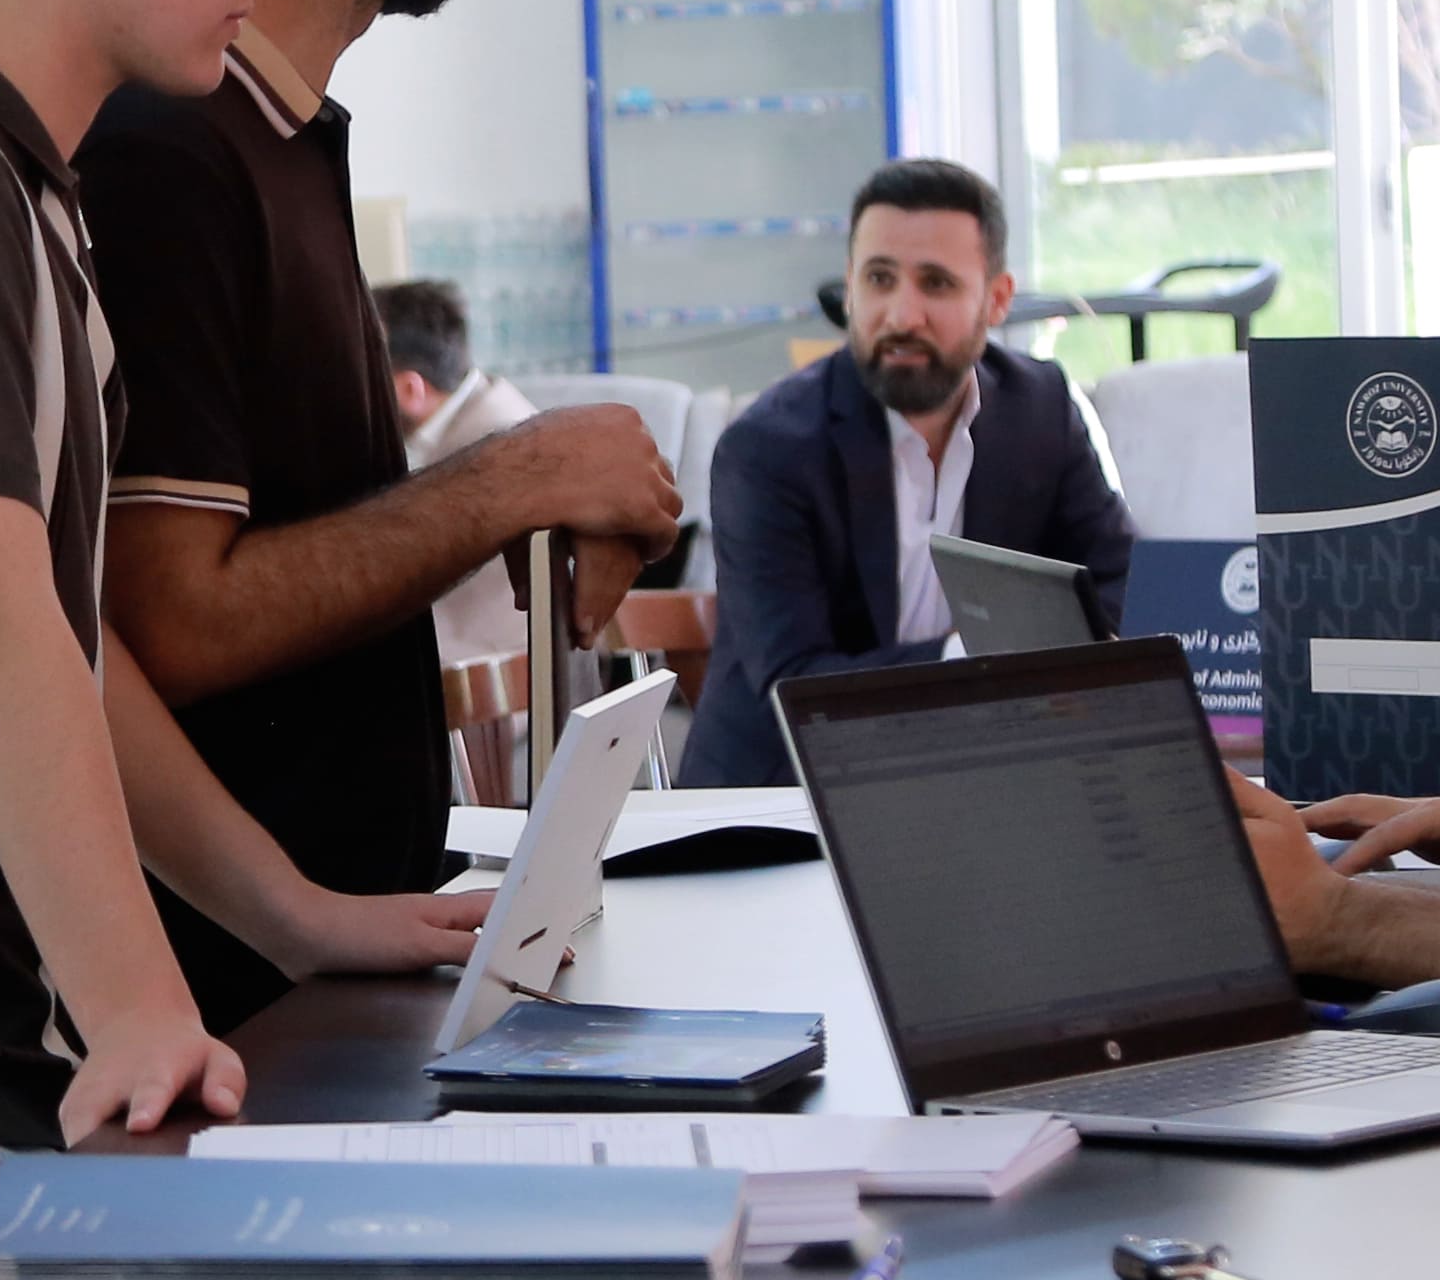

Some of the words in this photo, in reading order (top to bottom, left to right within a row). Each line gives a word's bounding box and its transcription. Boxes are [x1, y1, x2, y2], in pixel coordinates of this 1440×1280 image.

[1383, 381, 1430, 425] UNIVERSITY
[1193, 667, 1209, 688] of
[1195, 691, 1263, 711] conomic
